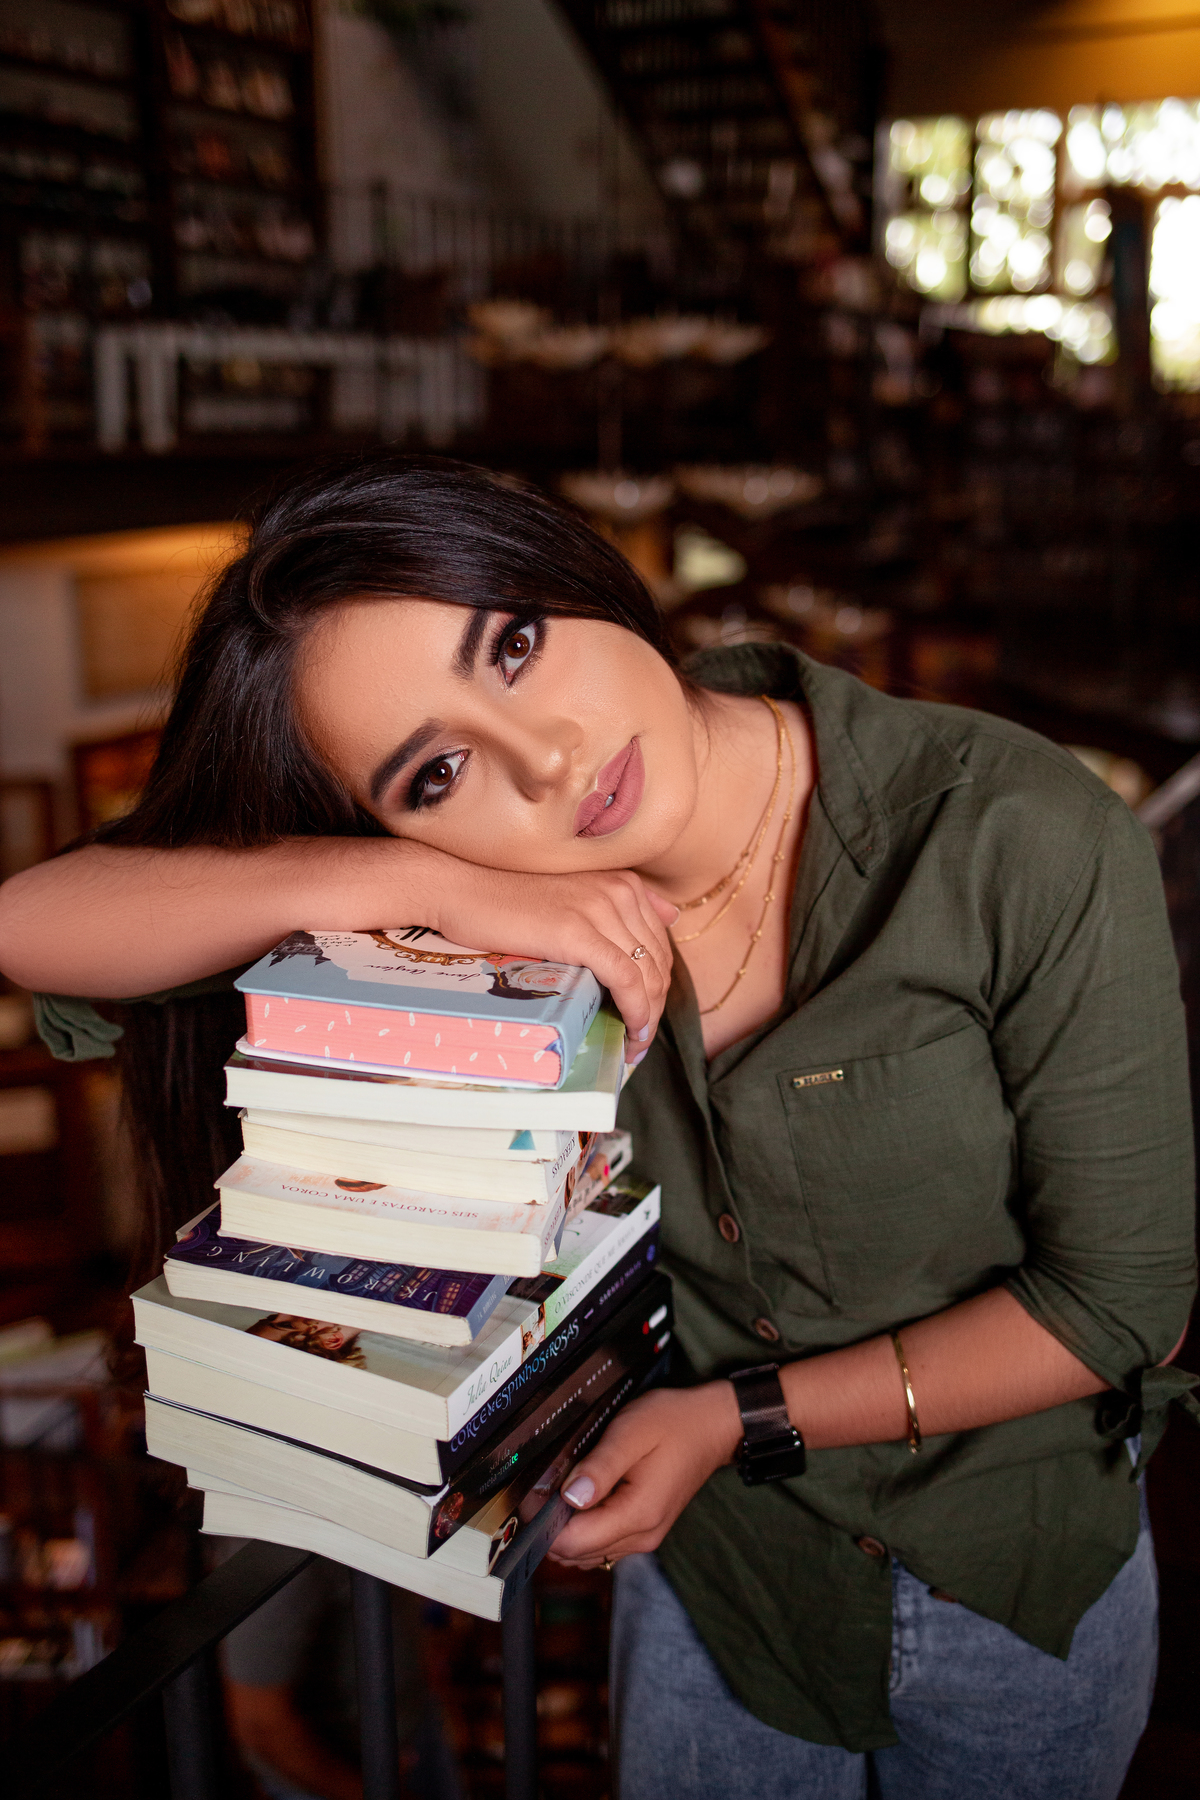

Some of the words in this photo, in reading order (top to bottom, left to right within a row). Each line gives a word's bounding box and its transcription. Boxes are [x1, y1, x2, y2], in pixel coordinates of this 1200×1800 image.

[281, 1184, 329, 1198] COROA
[334, 1193, 366, 1204] UMA
[382, 1200, 448, 1216] GAROTAS
[452, 1210, 480, 1219] SEIS
[206, 1245, 380, 1291] ROWLING
[450, 1408, 487, 1453] CORTE
[549, 1318, 580, 1357] ROSAS
[534, 1387, 582, 1436] STEPHENIE
